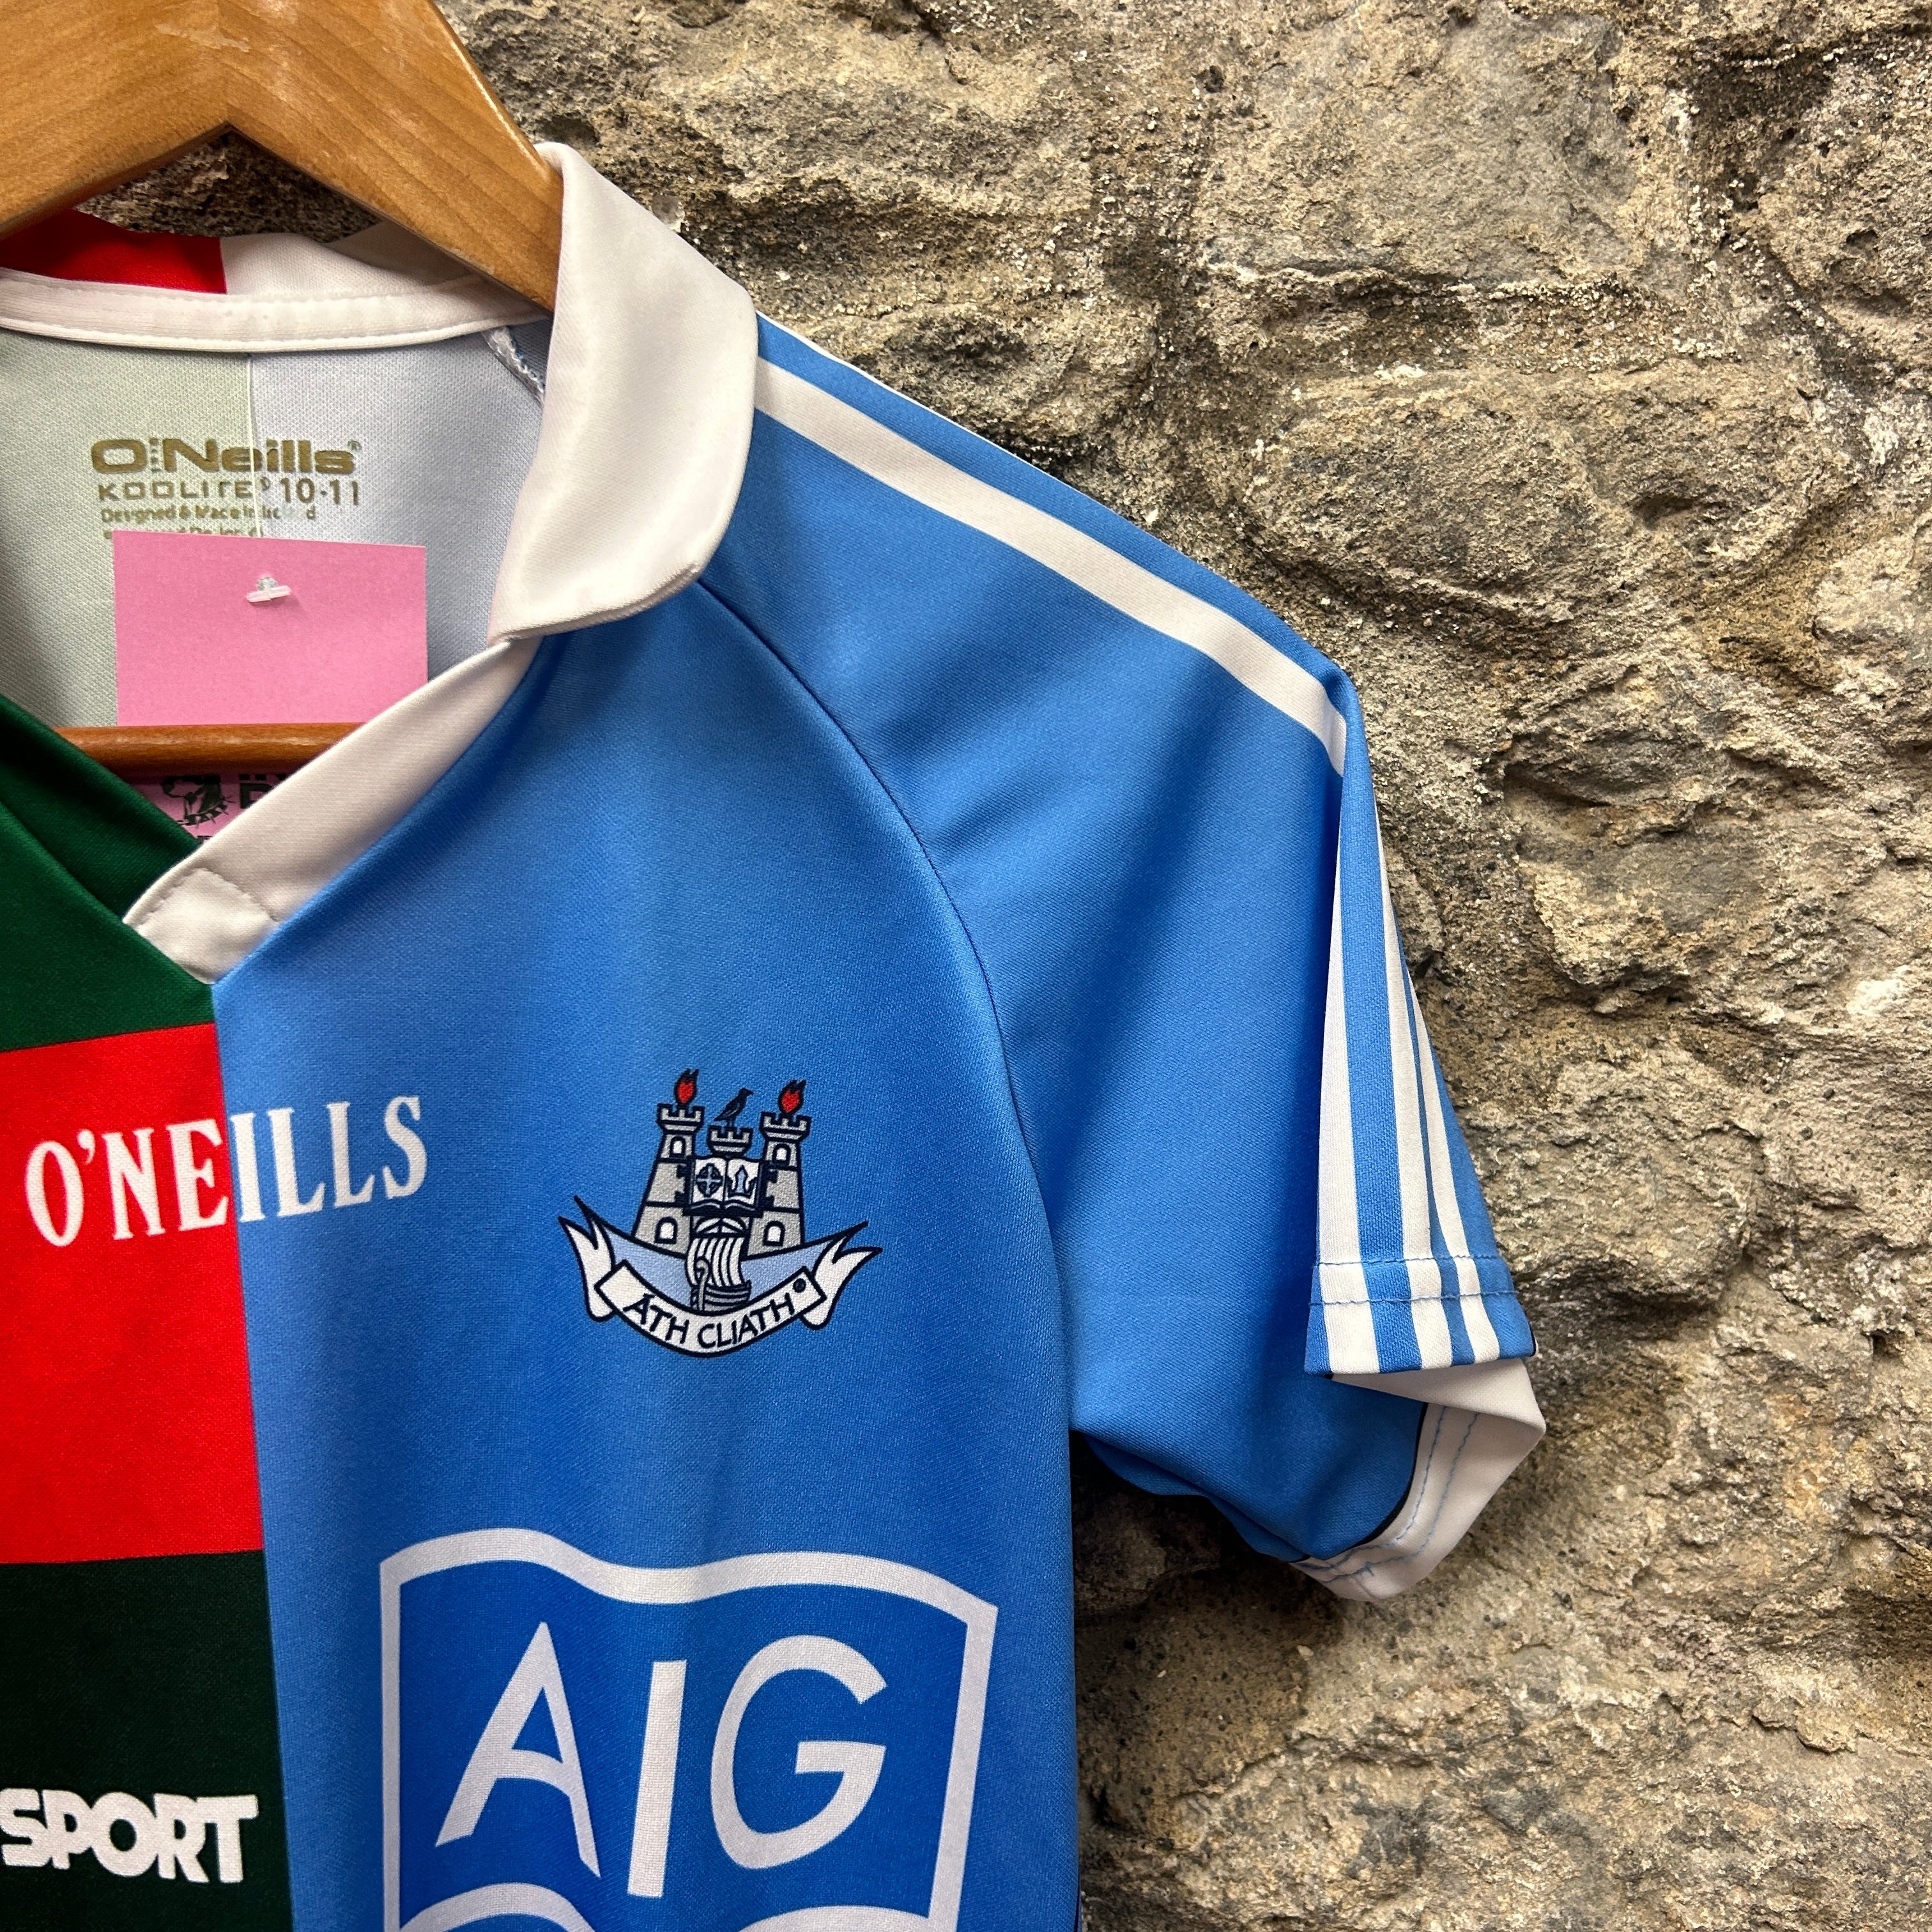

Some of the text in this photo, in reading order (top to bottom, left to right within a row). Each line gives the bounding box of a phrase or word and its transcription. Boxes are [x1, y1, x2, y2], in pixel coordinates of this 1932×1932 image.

[25, 1095, 427, 1247] O'NEILLS
[697, 1292, 795, 1349] CLIATH
[435, 1621, 888, 1898] AIG
[0, 1788, 259, 1883] SPORT
